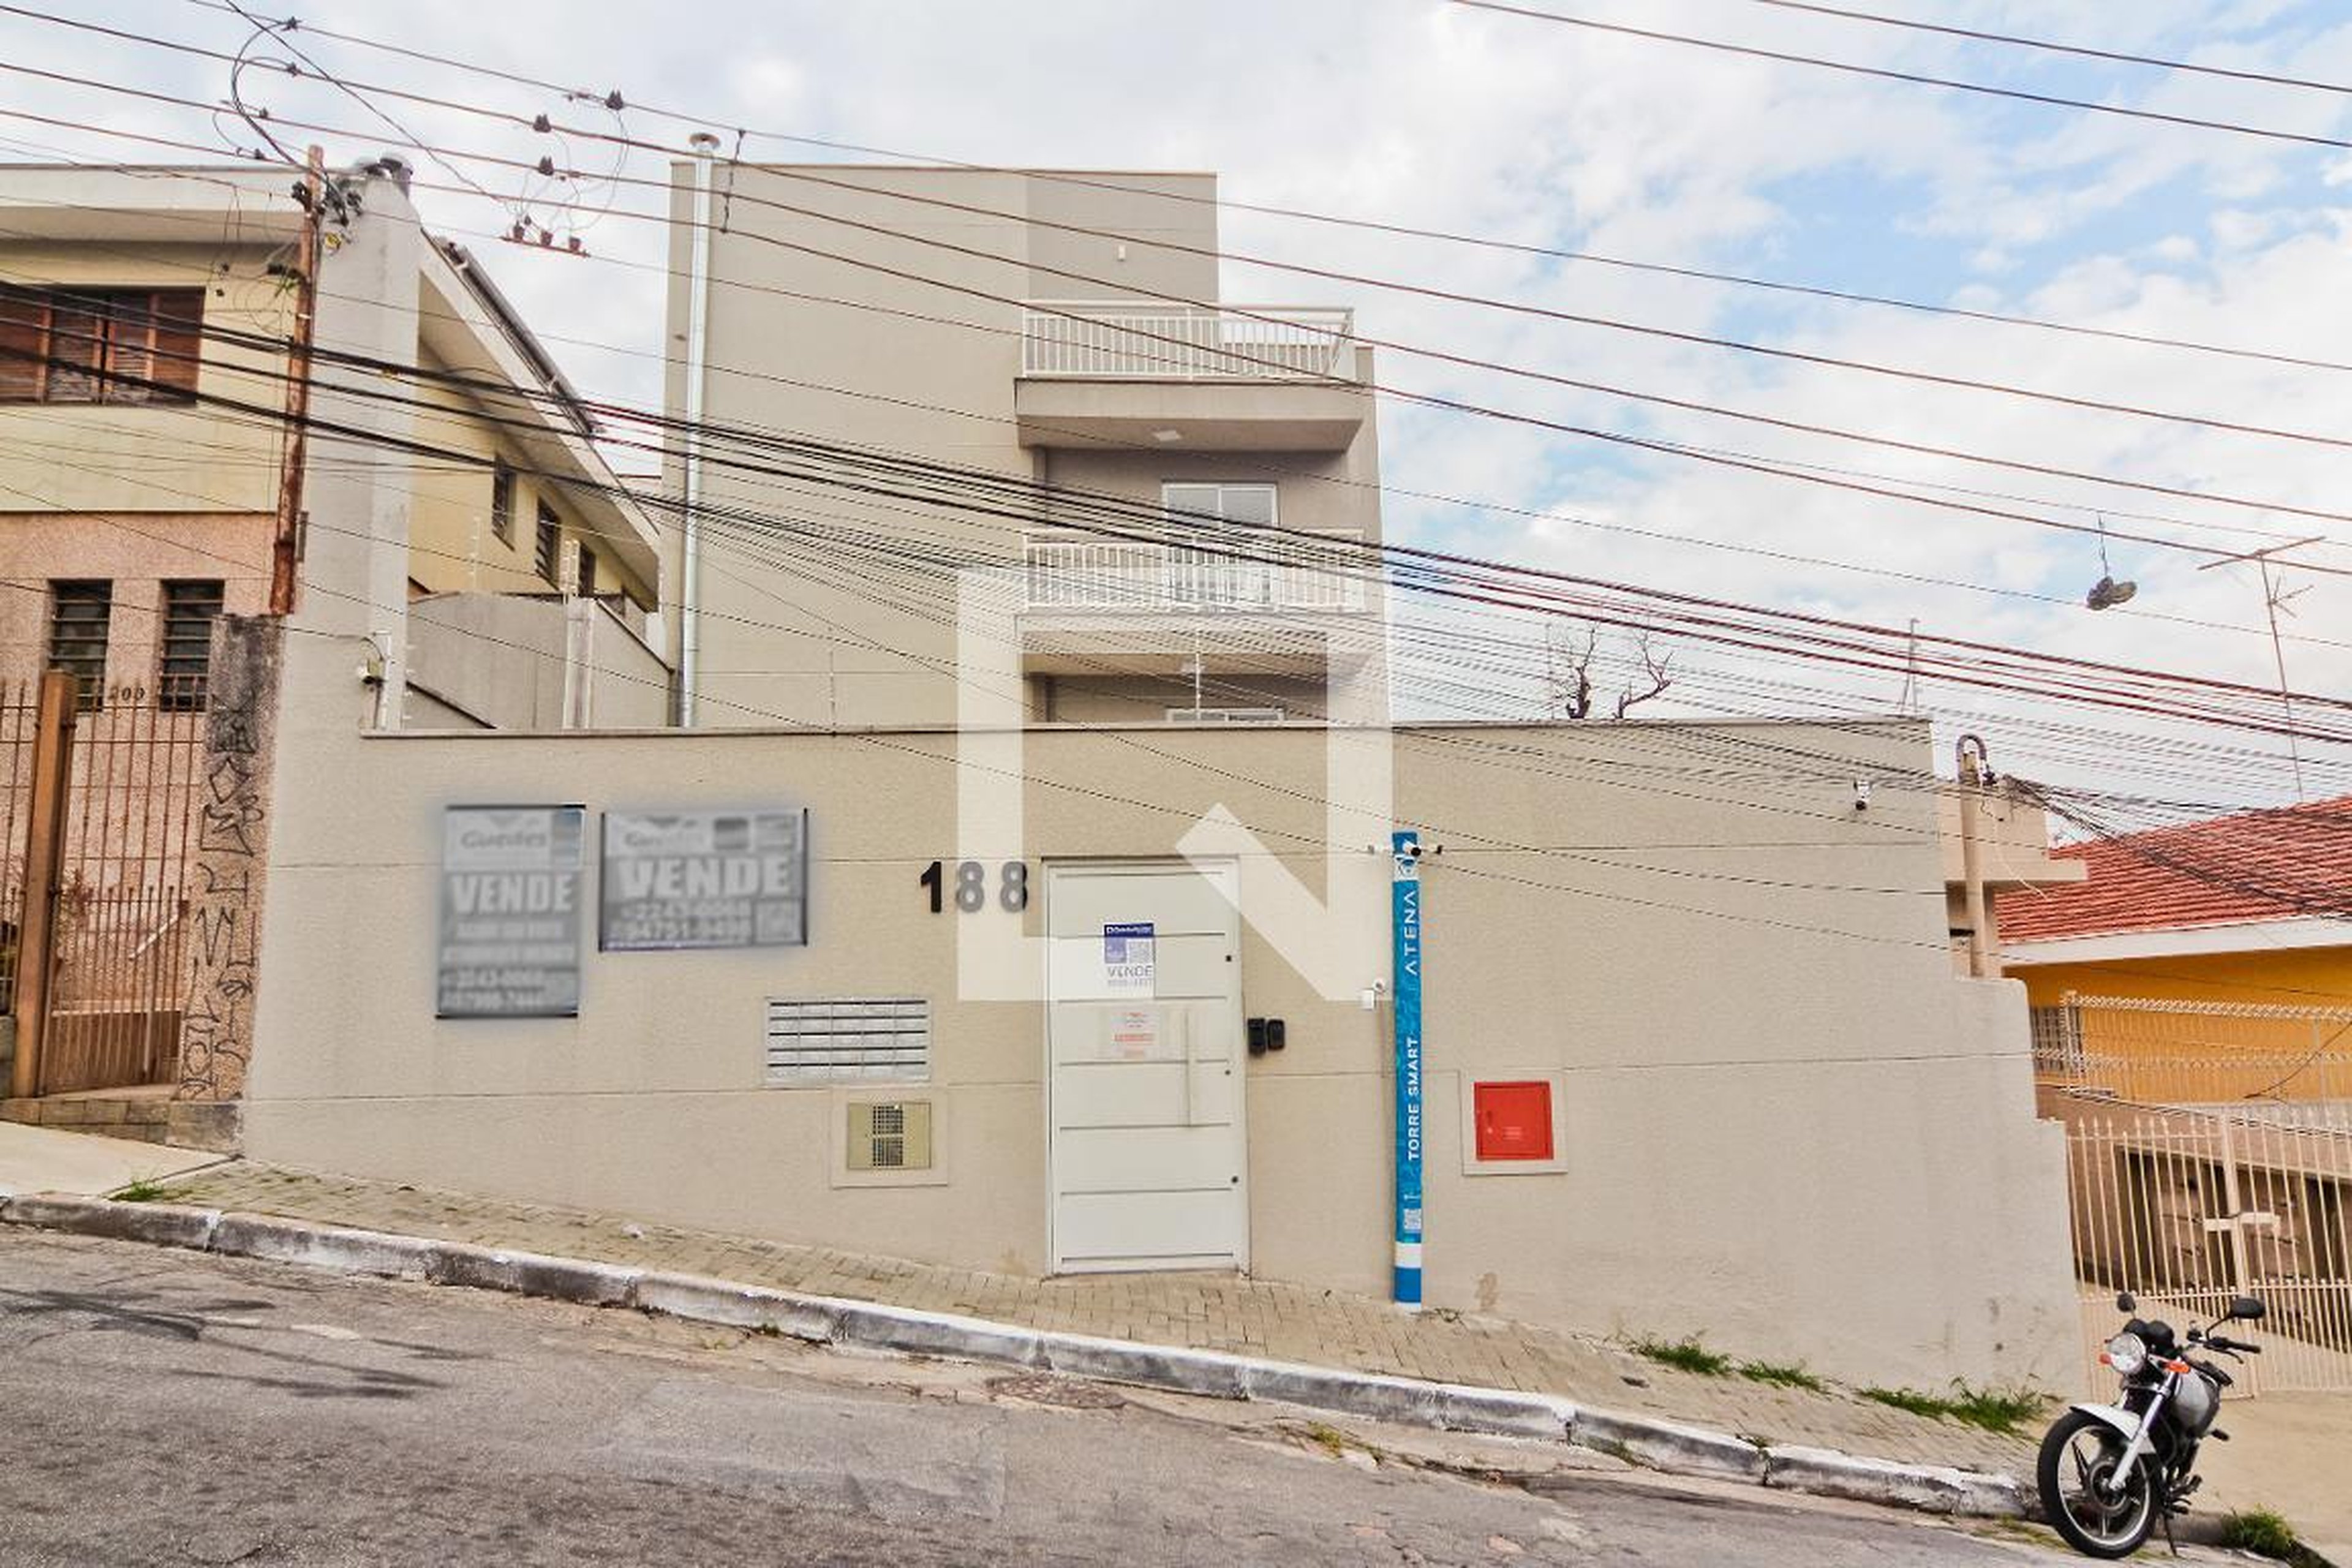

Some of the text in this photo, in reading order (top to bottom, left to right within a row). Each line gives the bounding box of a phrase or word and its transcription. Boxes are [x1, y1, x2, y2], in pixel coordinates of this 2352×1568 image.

[451, 873, 573, 914] VENDE
[617, 856, 790, 899] VENDE
[920, 861, 1028, 913] 188
[1403, 890, 1419, 977] ATENA
[1406, 1036, 1420, 1161] TORRE SMART
